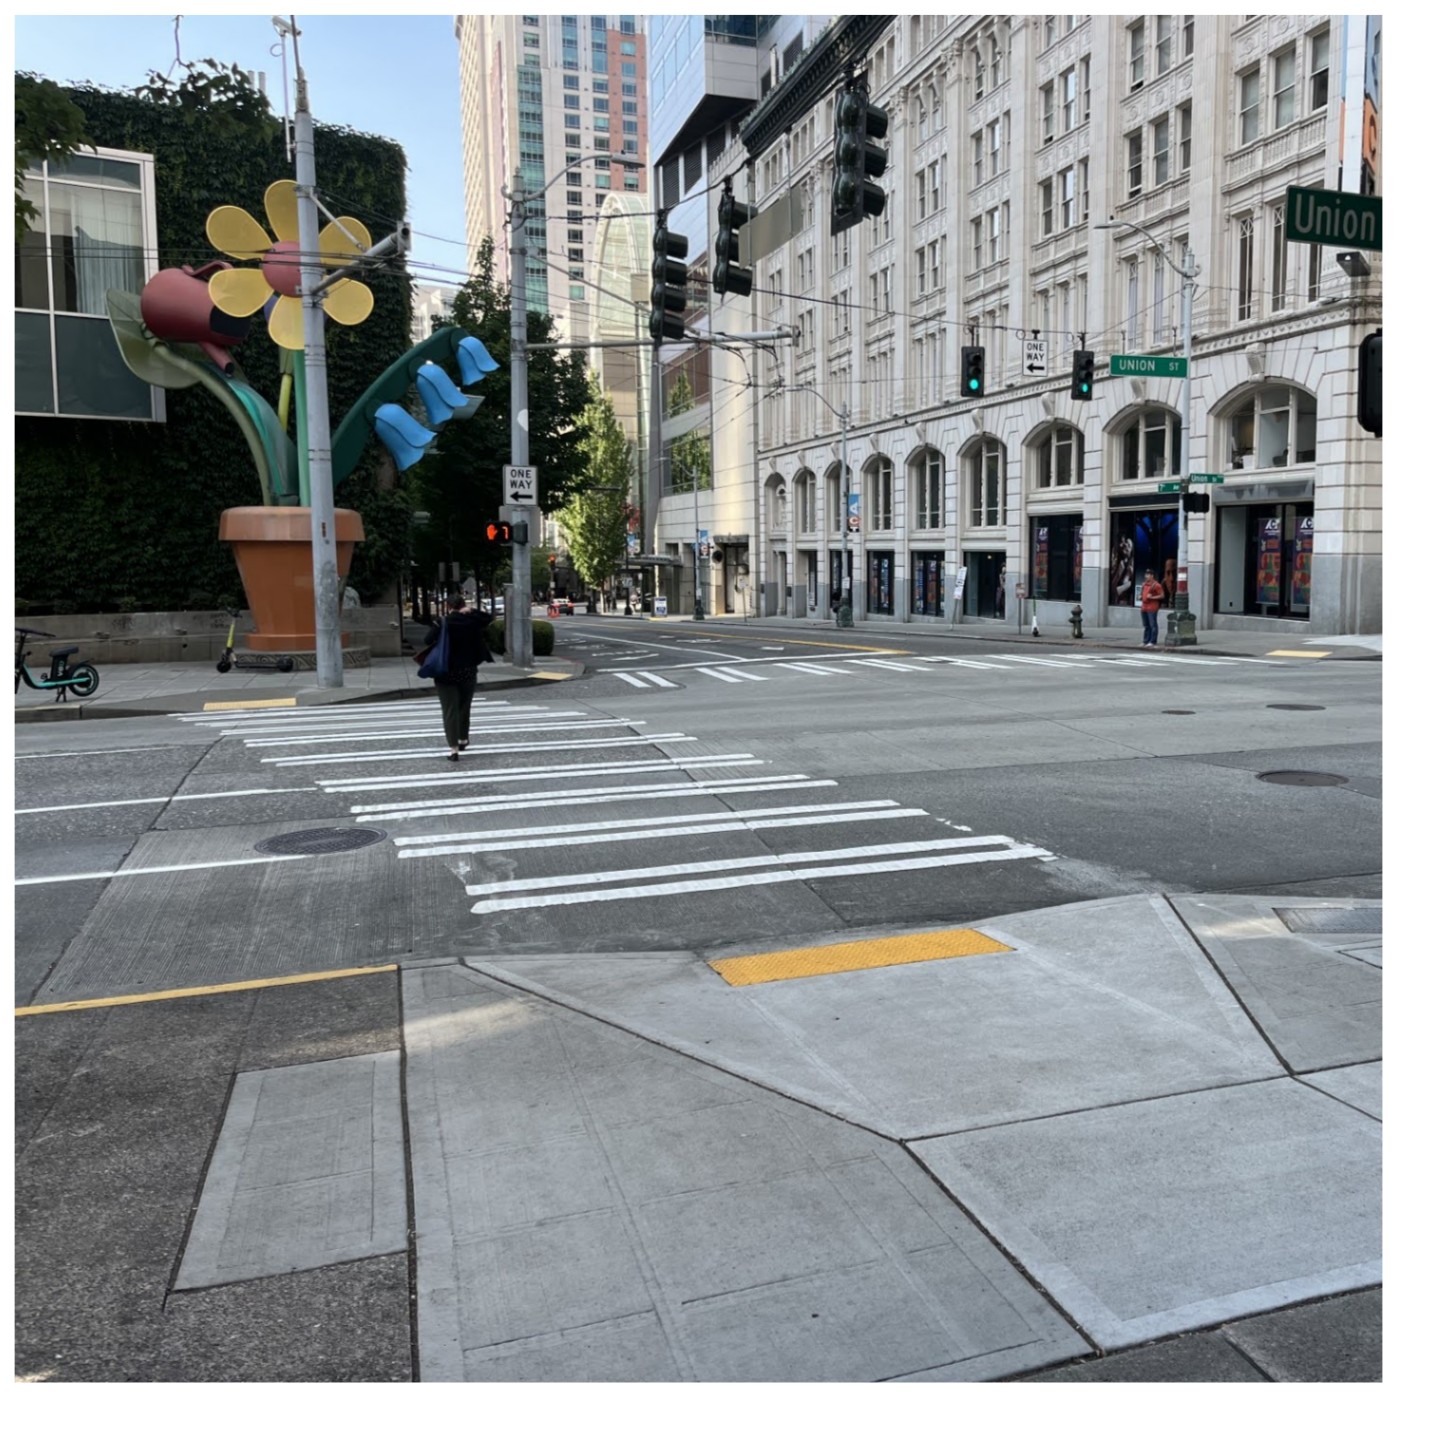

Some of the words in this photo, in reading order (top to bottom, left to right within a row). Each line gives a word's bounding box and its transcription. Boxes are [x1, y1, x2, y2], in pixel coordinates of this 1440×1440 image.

[1295, 192, 1376, 243] Union
[1026, 342, 1045, 352] ONE
[1026, 352, 1045, 362] WAY
[1118, 358, 1156, 372] UNION
[1168, 362, 1180, 372] ST
[510, 469, 532, 479] ONE
[510, 479, 533, 490] WAY
[502, 526, 509, 540] 7
